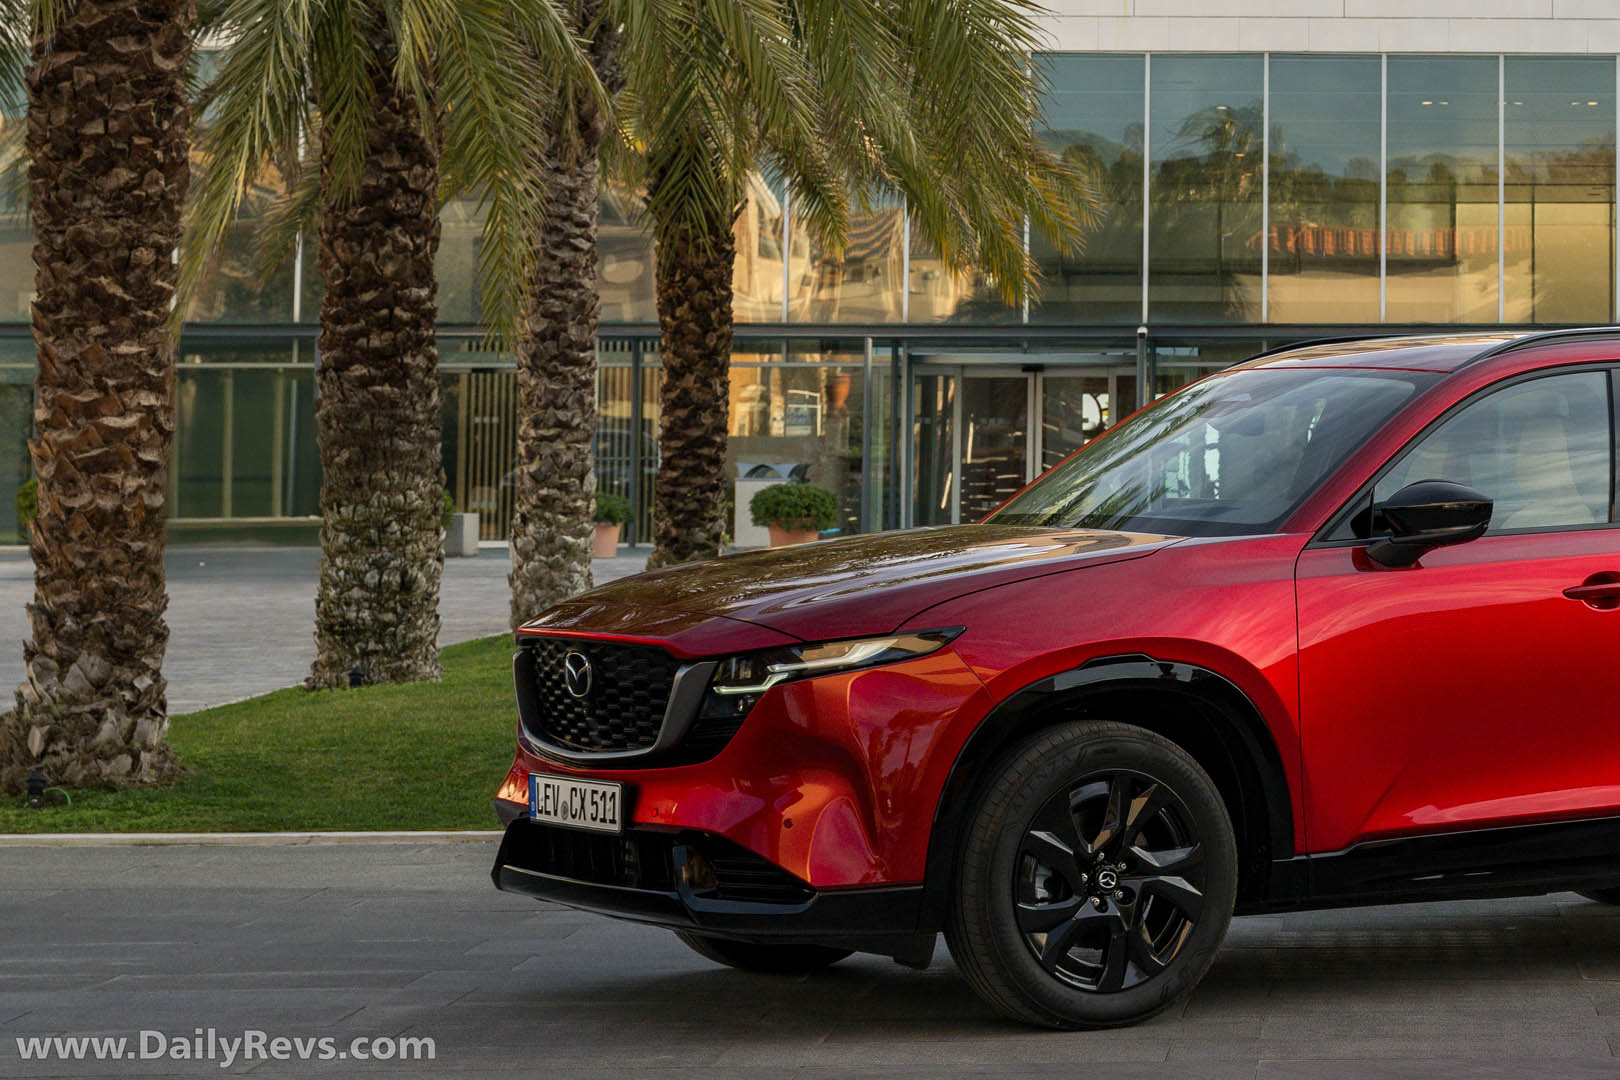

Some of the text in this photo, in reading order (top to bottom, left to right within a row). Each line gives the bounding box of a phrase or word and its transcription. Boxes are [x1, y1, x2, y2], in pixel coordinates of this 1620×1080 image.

[536, 781, 617, 825] LEV CX 511
